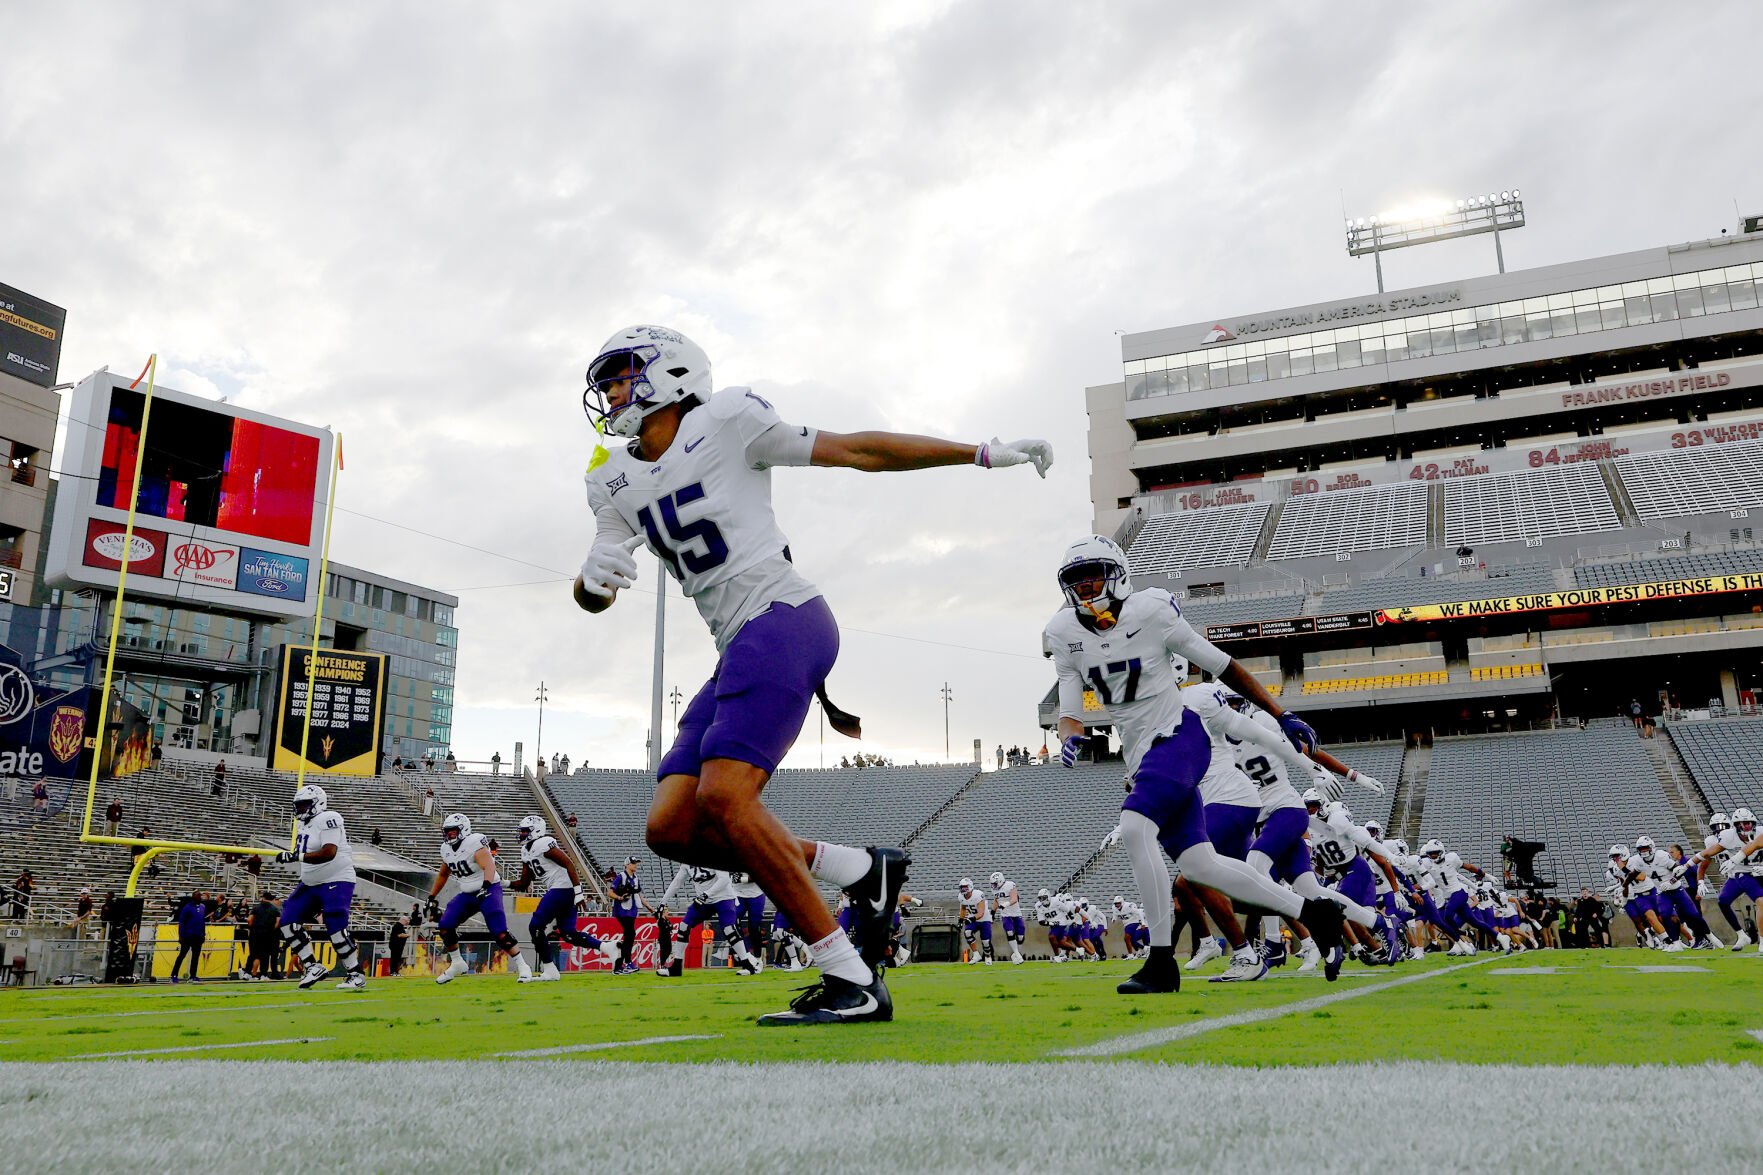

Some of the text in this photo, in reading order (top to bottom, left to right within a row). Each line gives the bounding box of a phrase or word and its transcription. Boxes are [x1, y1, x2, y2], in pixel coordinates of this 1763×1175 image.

[6, 303, 15, 312] at
[1236, 288, 1462, 336] MOUNTAIN AMERICA STADIUM
[7, 352, 24, 365] ASU
[1562, 373, 1731, 408] FRANK KUSH FIELD
[745, 392, 774, 410] 1
[1671, 430, 1704, 449] 33
[1578, 442, 1611, 454] JOHN
[1453, 459, 1475, 469] PAT
[1529, 448, 1561, 468] 84
[1336, 473, 1359, 483] BOB
[1441, 465, 1489, 478] TILLMAN
[1215, 488, 1243, 498] JAKE
[1291, 478, 1320, 497] 50
[1179, 493, 1202, 511] 16
[1203, 494, 1255, 508] PLUMMER
[637, 481, 729, 581] 15
[1528, 538, 1541, 546] 303
[1664, 540, 1678, 548] 203
[177, 545, 211, 570] AAA
[1338, 552, 1351, 561] 302
[1460, 557, 1473, 565] 202
[244, 563, 303, 583] SAN TAN FORD
[1168, 571, 1181, 580] 301
[1440, 603, 1464, 617] WE
[1469, 598, 1512, 615] MAKE
[1516, 594, 1554, 609] SURE
[1556, 590, 1602, 606] YOUR
[1606, 585, 1640, 601] PEST
[1645, 578, 1719, 598] DEFENSE,
[1723, 577, 1738, 591] IS
[1262, 621, 1292, 629] LOUISVILLE
[1262, 627, 1296, 635] PITTSBURGH
[1224, 631, 1243, 639] FOREST
[303, 655, 367, 671] CNFERENCE
[1088, 657, 1141, 705] 17
[293, 682, 371, 697] 1931 1939 1940 1952
[313, 693, 330, 701] 1959
[334, 694, 349, 703] 1961
[354, 696, 371, 705] 1969
[312, 701, 328, 710] 1971
[333, 703, 350, 712] 1972
[353, 705, 370, 713] 1973
[311, 710, 328, 719] 1977
[310, 718, 350, 729] 2007 2024
[1, 746, 43, 775] ate
[1235, 755, 1278, 788] 2
[326, 819, 338, 829] 61
[1317, 840, 1346, 866] 18
[448, 860, 476, 878] 60
[9, 929, 19, 937] 40
